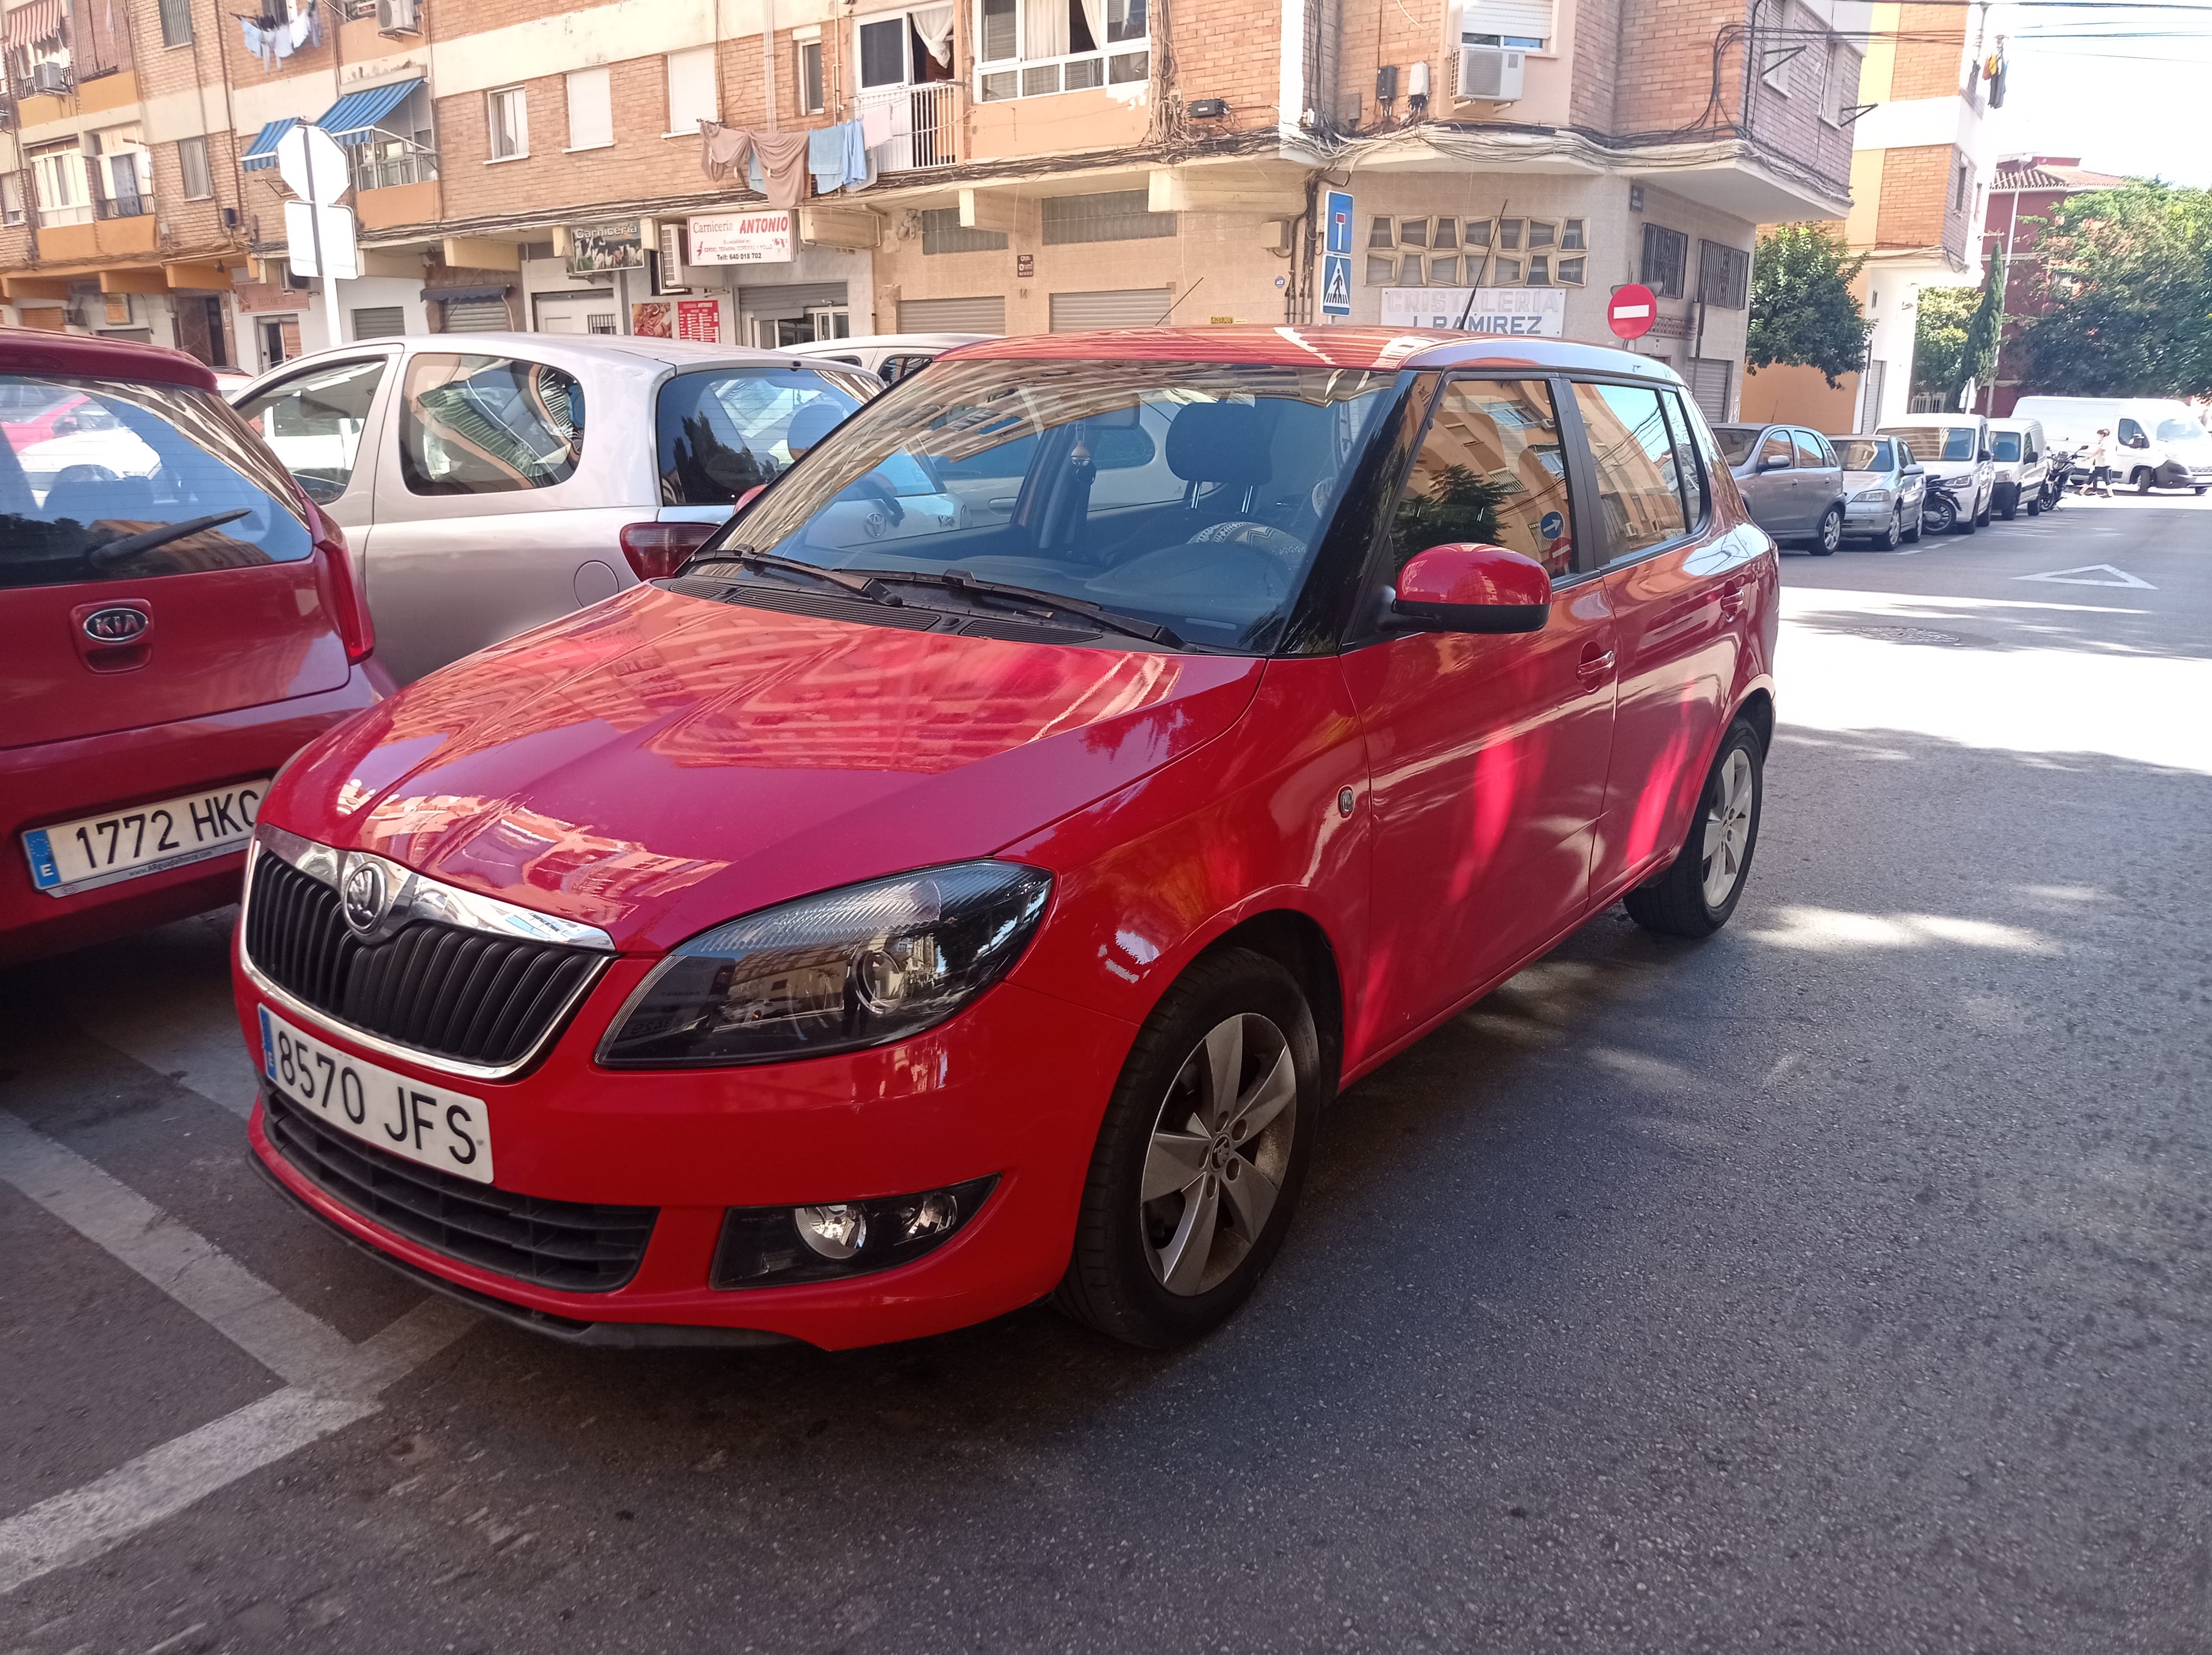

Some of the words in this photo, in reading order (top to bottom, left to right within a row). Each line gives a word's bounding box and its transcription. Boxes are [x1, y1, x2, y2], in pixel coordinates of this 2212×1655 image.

[576, 222, 637, 238] Carnicería
[693, 220, 733, 233] Carnicería
[739, 216, 788, 234] ANTONIO
[1020, 289, 1027, 300] 14
[1433, 316, 1542, 335] RAMIREZ
[94, 615, 140, 634] KIA
[76, 809, 180, 869] 1772
[40, 863, 54, 877] E
[279, 1031, 366, 1124] 8570
[384, 1086, 477, 1165] JFS
